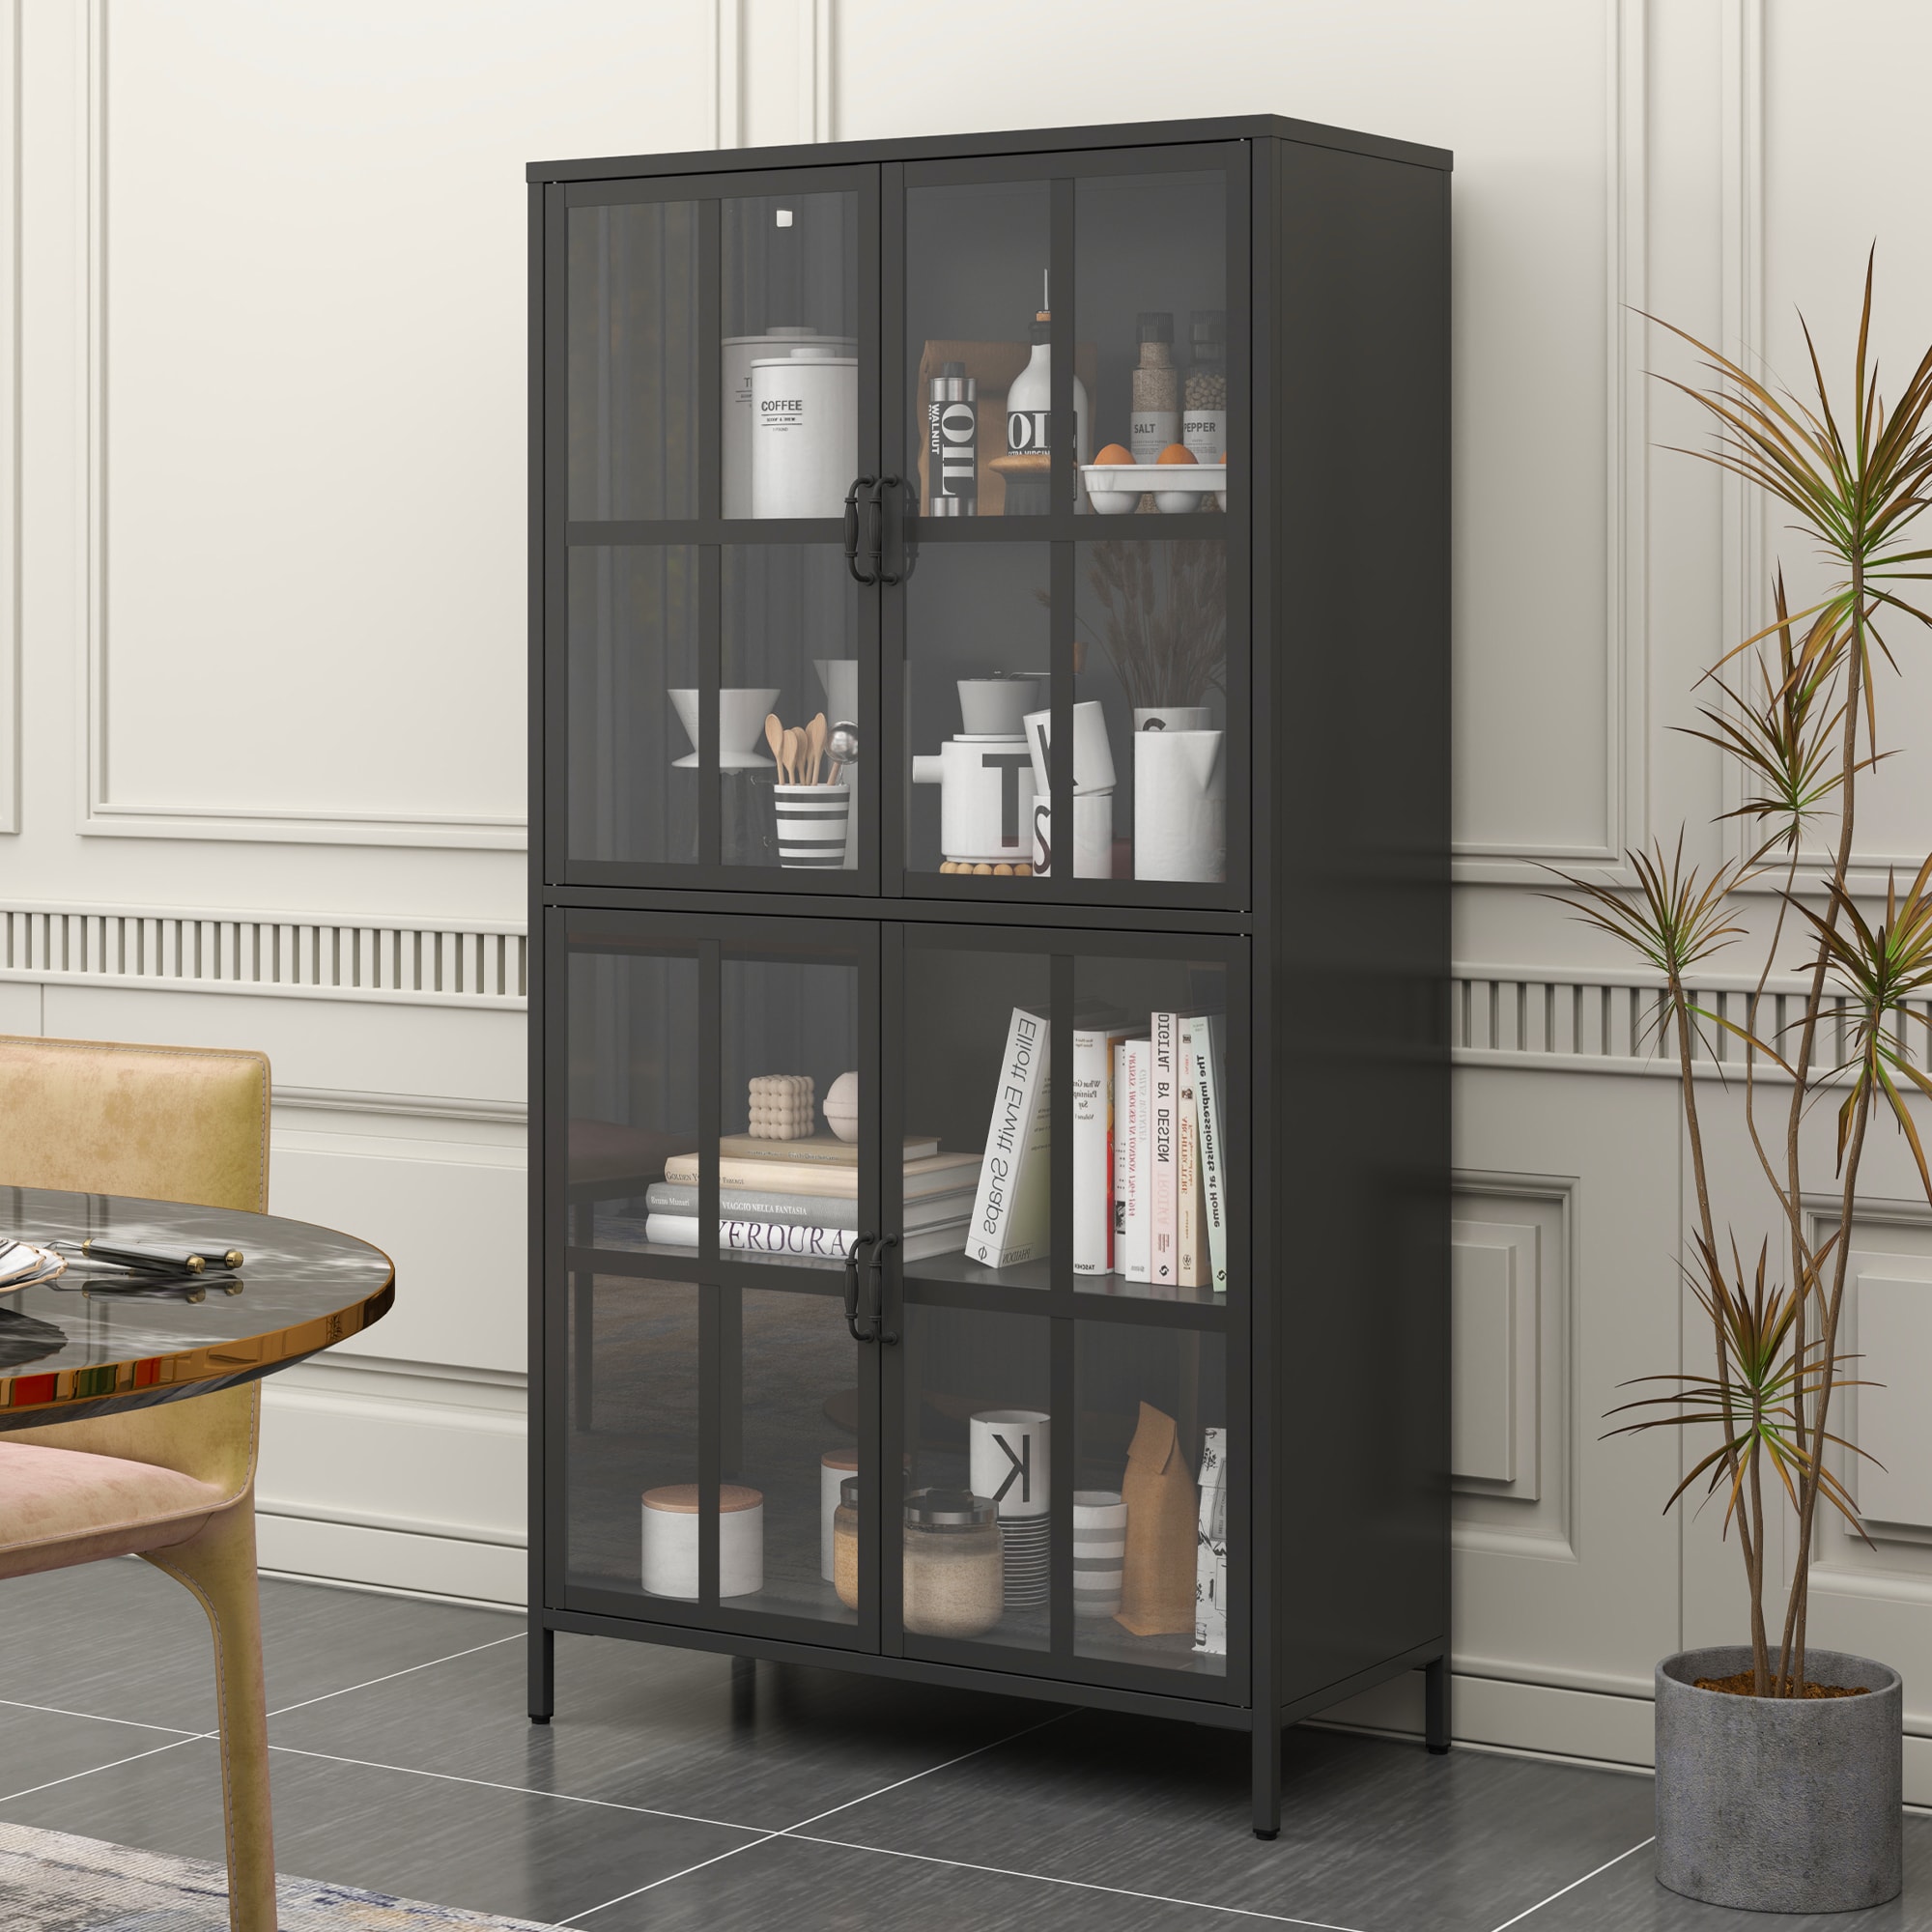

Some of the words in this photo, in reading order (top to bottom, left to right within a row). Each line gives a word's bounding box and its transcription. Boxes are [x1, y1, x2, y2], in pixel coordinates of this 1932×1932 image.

[761, 400, 803, 412] COFFEE
[931, 404, 940, 455] WALNUT
[1008, 412, 1051, 449] OI
[1134, 423, 1156, 434] SALT
[1183, 422, 1216, 433] PEPPER
[942, 404, 975, 496] OIL
[982, 753, 1033, 847] T
[650, 1196, 668, 1206] Bruno
[668, 1197, 690, 1207] Munari
[722, 1201, 752, 1211] VIAGGIO
[752, 1203, 775, 1213] NELLA
[775, 1205, 808, 1215] FANTASIA
